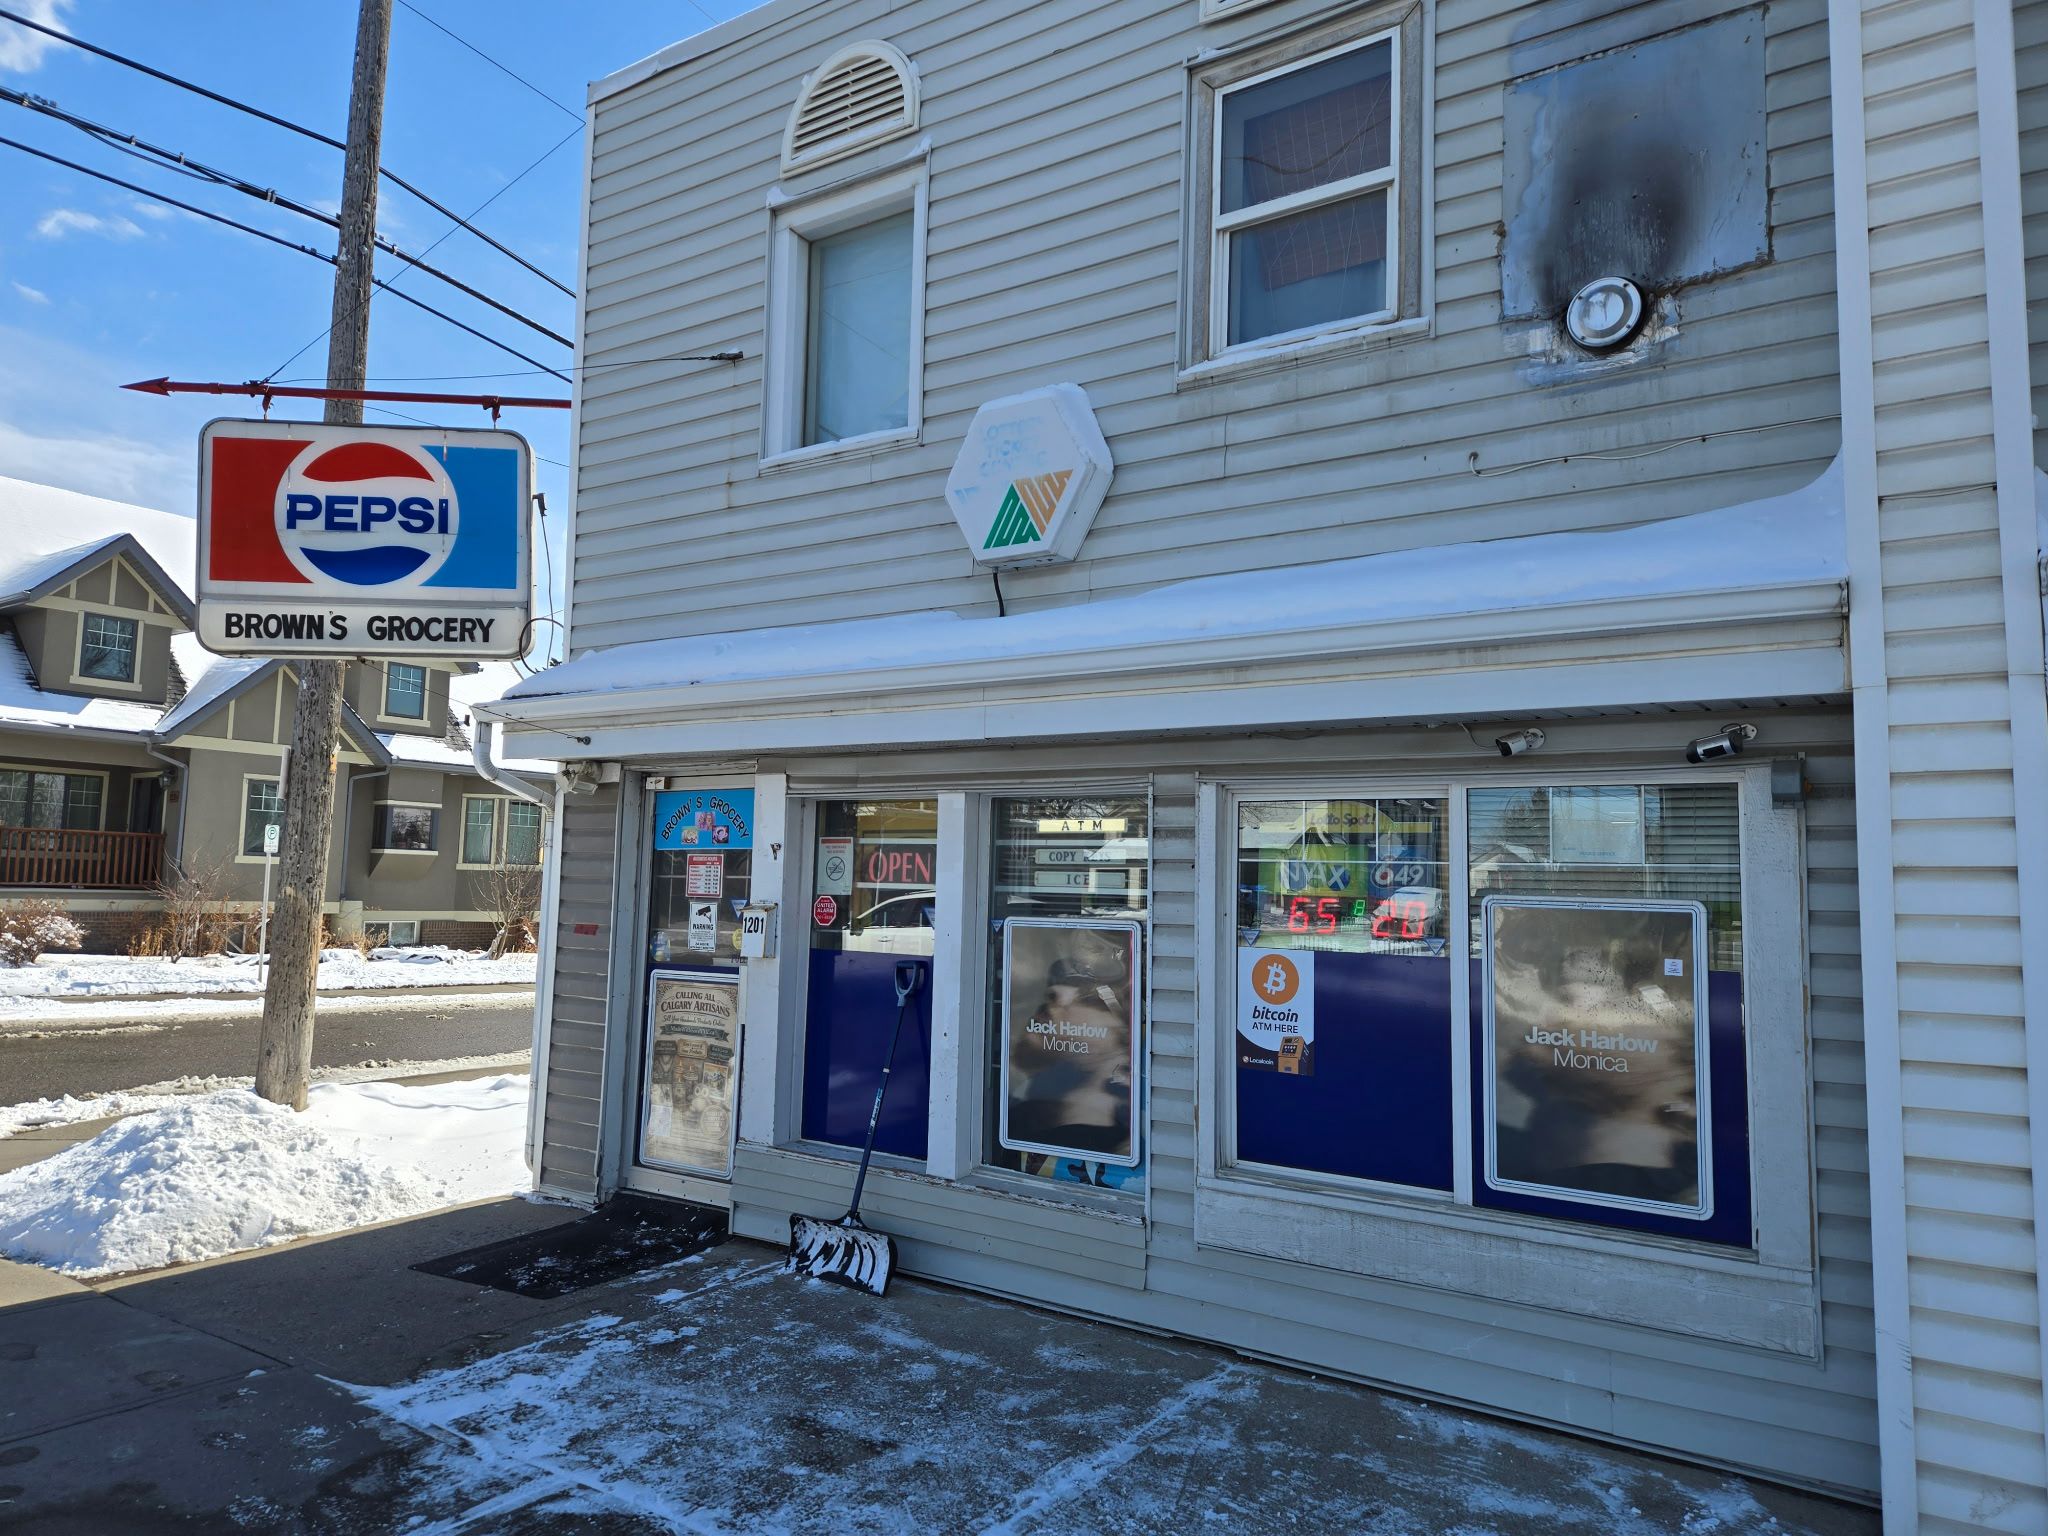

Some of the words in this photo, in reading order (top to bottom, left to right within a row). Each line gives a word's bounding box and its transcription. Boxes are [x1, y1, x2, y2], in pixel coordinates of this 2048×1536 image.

[286, 494, 449, 535] PEPSI
[224, 611, 348, 641] BROWN'S
[367, 616, 496, 643] GROCERY
[709, 796, 750, 839] GROCERY
[1048, 851, 1077, 862] COPY
[868, 851, 931, 883] OPEN
[1066, 874, 1090, 886] ICE
[743, 916, 765, 935] 1201
[1288, 897, 1340, 935] 65
[692, 923, 714, 931] WARNING
[675, 991, 703, 1000] CALLING
[704, 993, 715, 1002] ALL
[661, 1001, 693, 1012] CALGARY
[693, 1000, 730, 1018] ARTISANS
[1252, 1005, 1299, 1023] bitcoin
[1026, 1018, 1058, 1035] Jack
[1059, 1021, 1108, 1039] Harlow
[1252, 1021, 1272, 1032] ATM
[1274, 1023, 1299, 1034] HERE
[1043, 1035, 1089, 1054] Monica
[1524, 1025, 1576, 1047] Jack
[1579, 1029, 1658, 1054] Harlow
[1553, 1047, 1629, 1073] Monica
